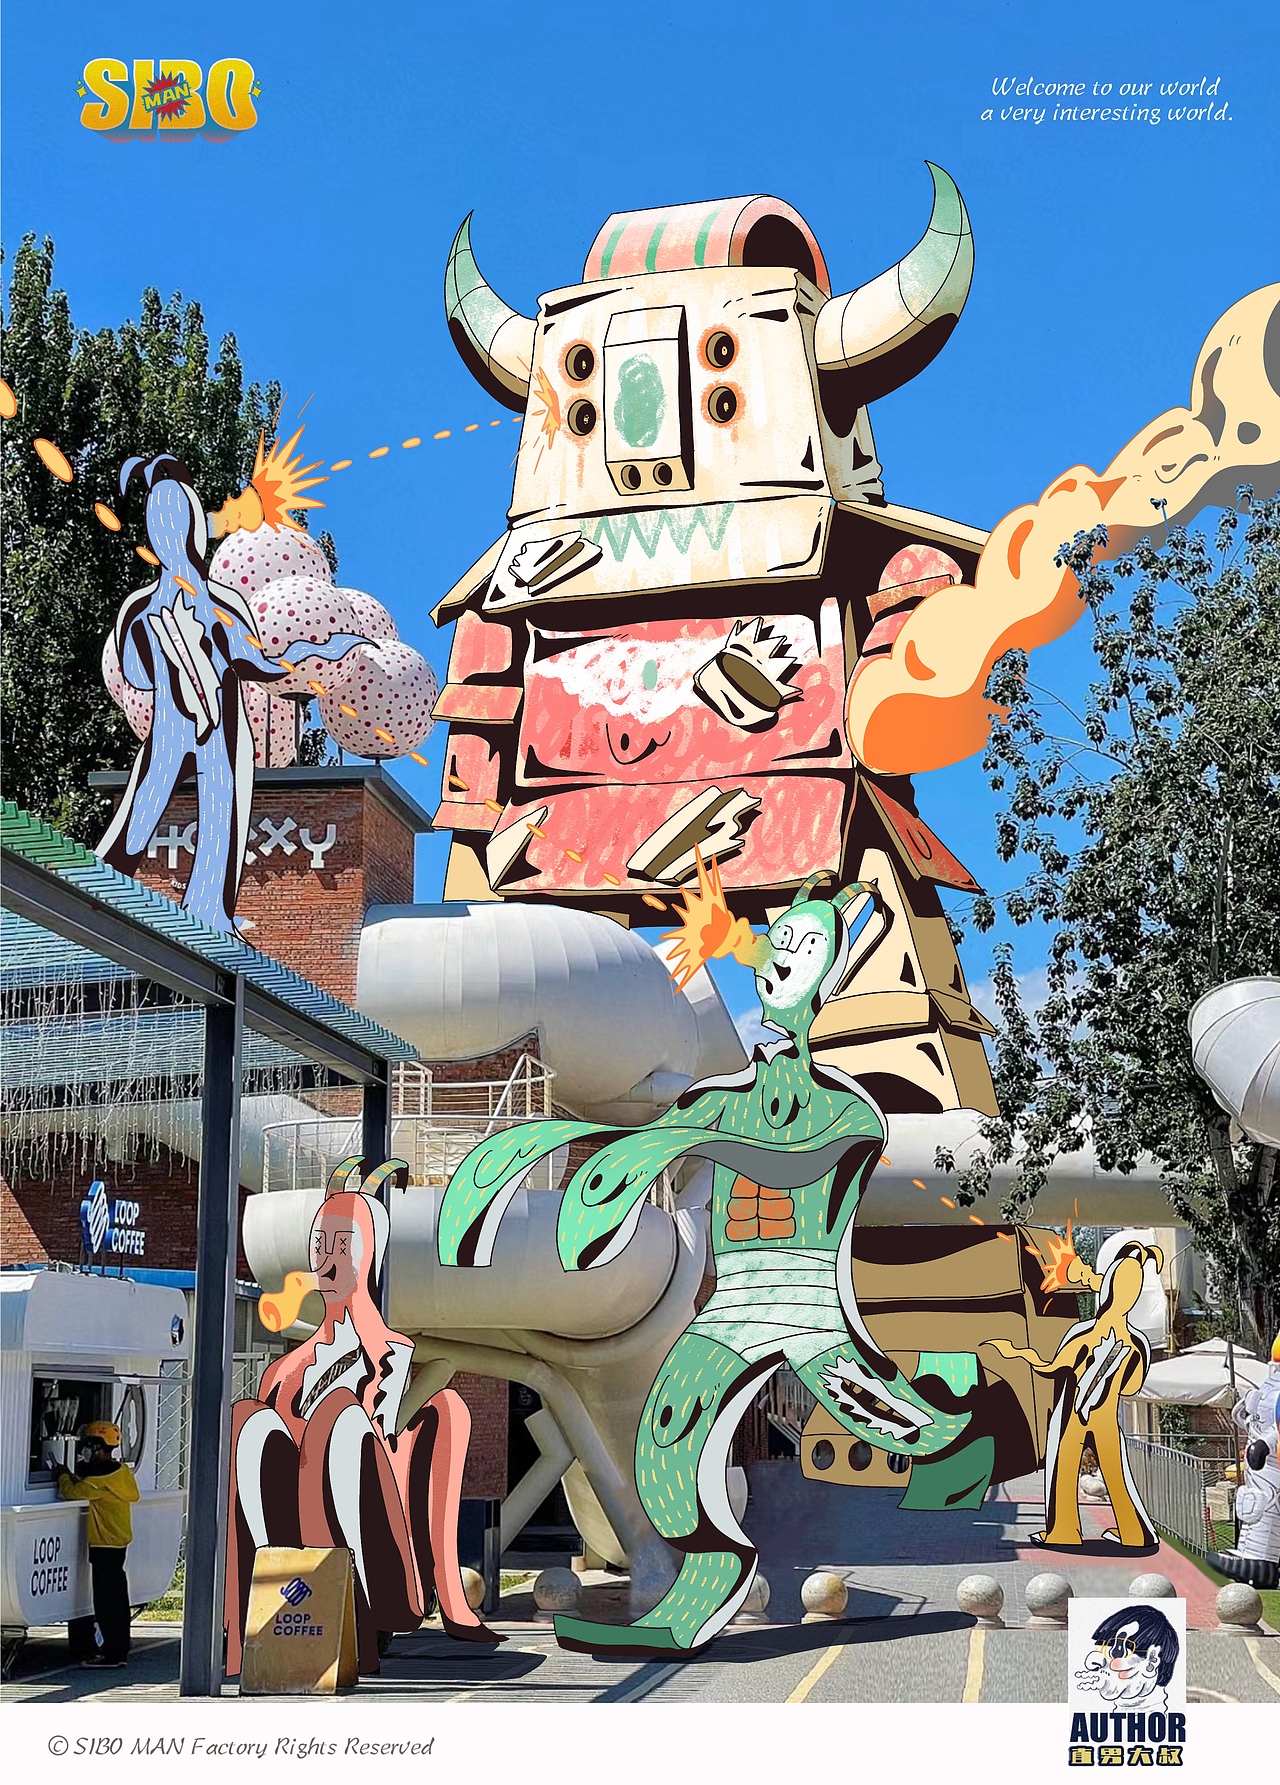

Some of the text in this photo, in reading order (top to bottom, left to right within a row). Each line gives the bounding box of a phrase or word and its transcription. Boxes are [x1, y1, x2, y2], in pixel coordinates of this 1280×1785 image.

[115, 1200, 139, 1226] LOOP
[112, 1228, 145, 1255] COFFEE
[33, 1537, 61, 1564] LOOP
[31, 1566, 68, 1596] COFFEE
[273, 1625, 323, 1636] COFFEE
[276, 1613, 311, 1625] LOOP
